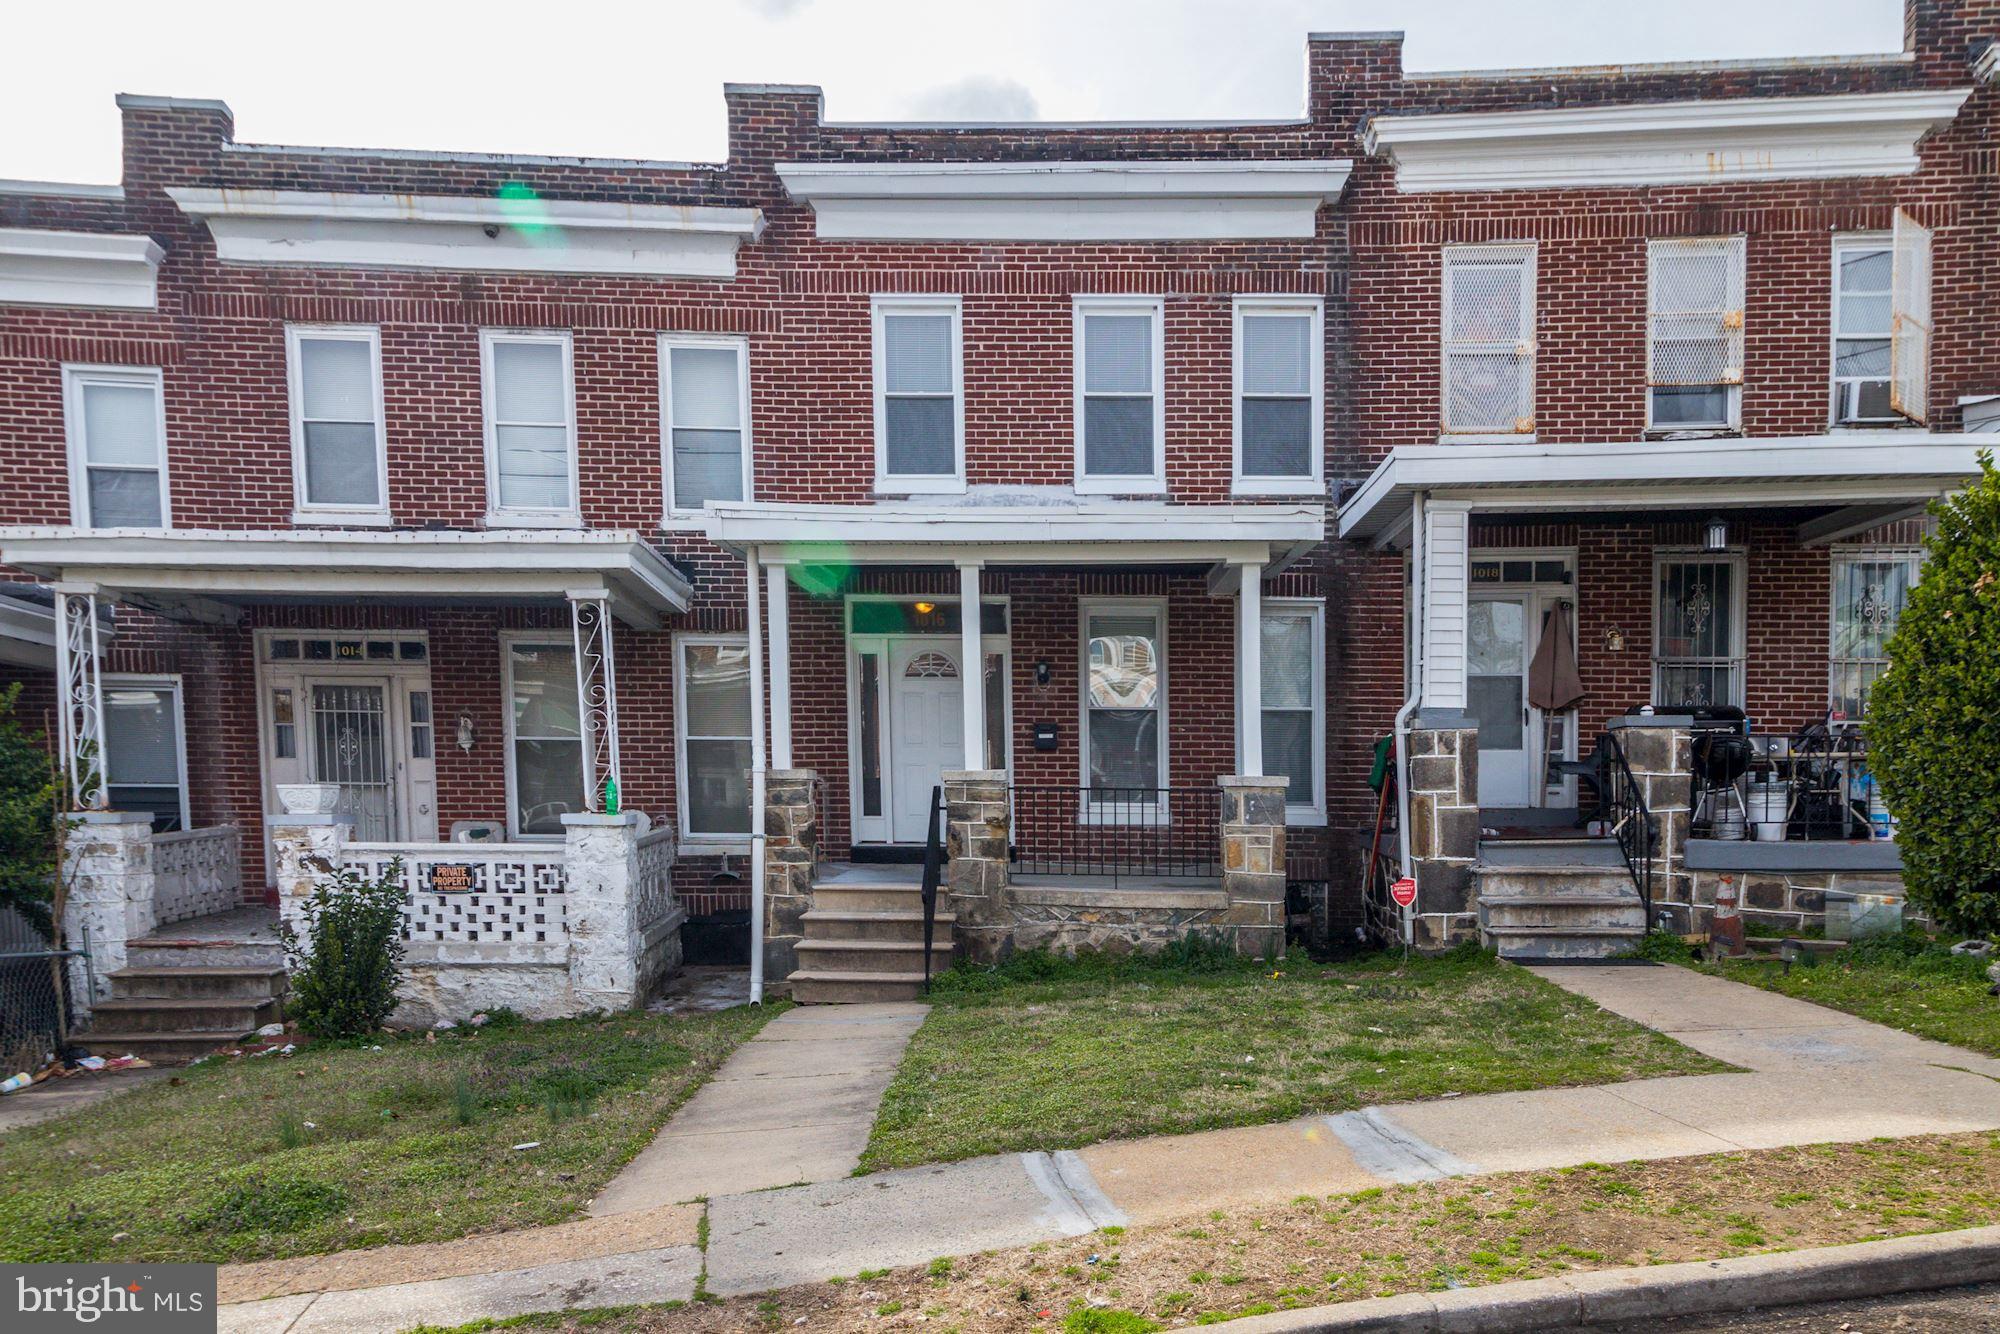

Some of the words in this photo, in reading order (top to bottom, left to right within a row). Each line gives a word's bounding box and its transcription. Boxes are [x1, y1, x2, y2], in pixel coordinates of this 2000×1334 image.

[1472, 567, 1499, 578] 1018
[436, 867, 467, 877] PRIVATE
[432, 876, 472, 886] PROPERTY
